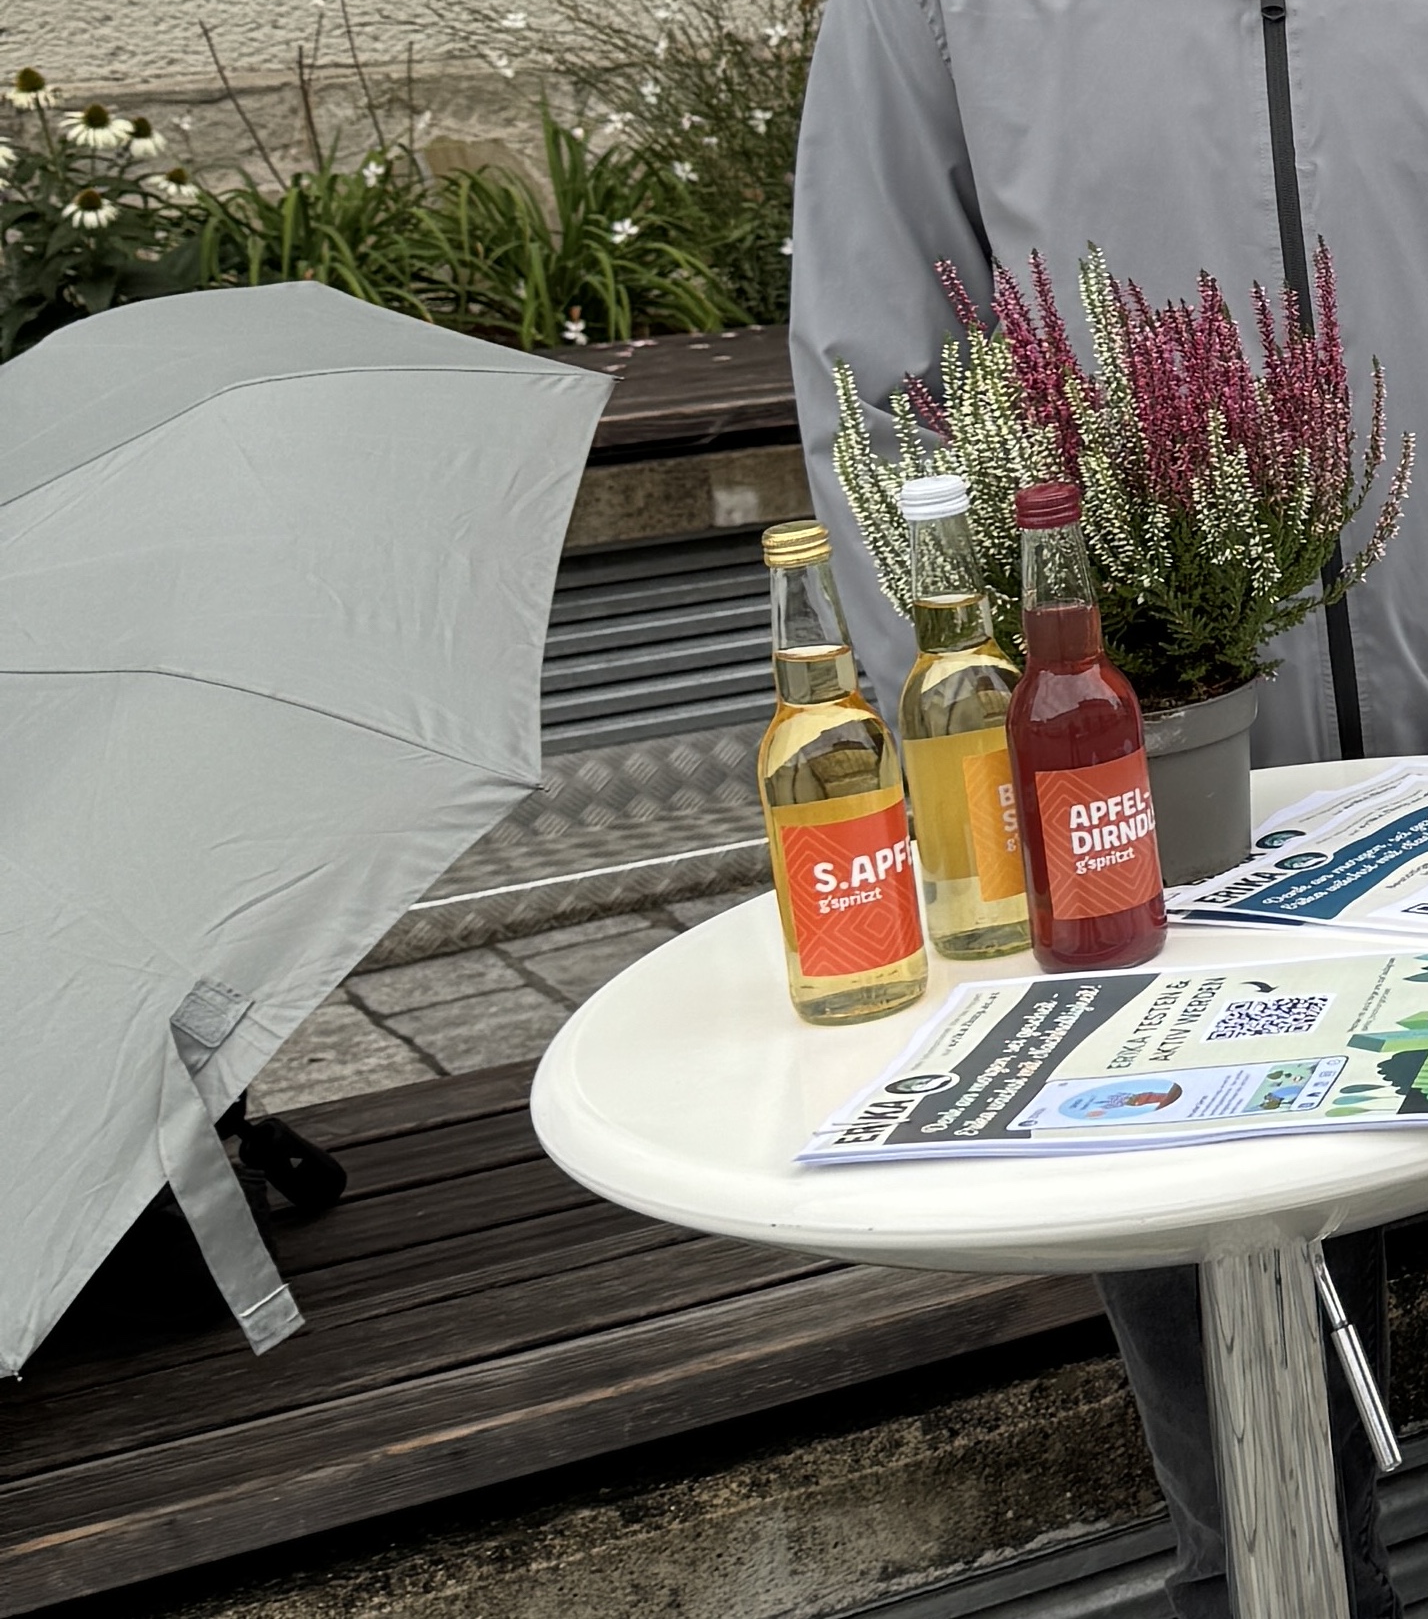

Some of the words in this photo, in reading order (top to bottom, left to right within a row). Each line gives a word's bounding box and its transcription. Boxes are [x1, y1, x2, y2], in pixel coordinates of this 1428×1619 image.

[1070, 788, 1149, 828] APFEL-
[813, 835, 912, 892] S.APF
[1193, 872, 1287, 903] ERIKA
[1106, 1036, 1151, 1069] ERIKA
[1133, 991, 1182, 1034] TESTEN
[1149, 1029, 1191, 1061] AKTIV
[1174, 977, 1226, 1025] WERDEN
[833, 1099, 914, 1144] ERIKA
